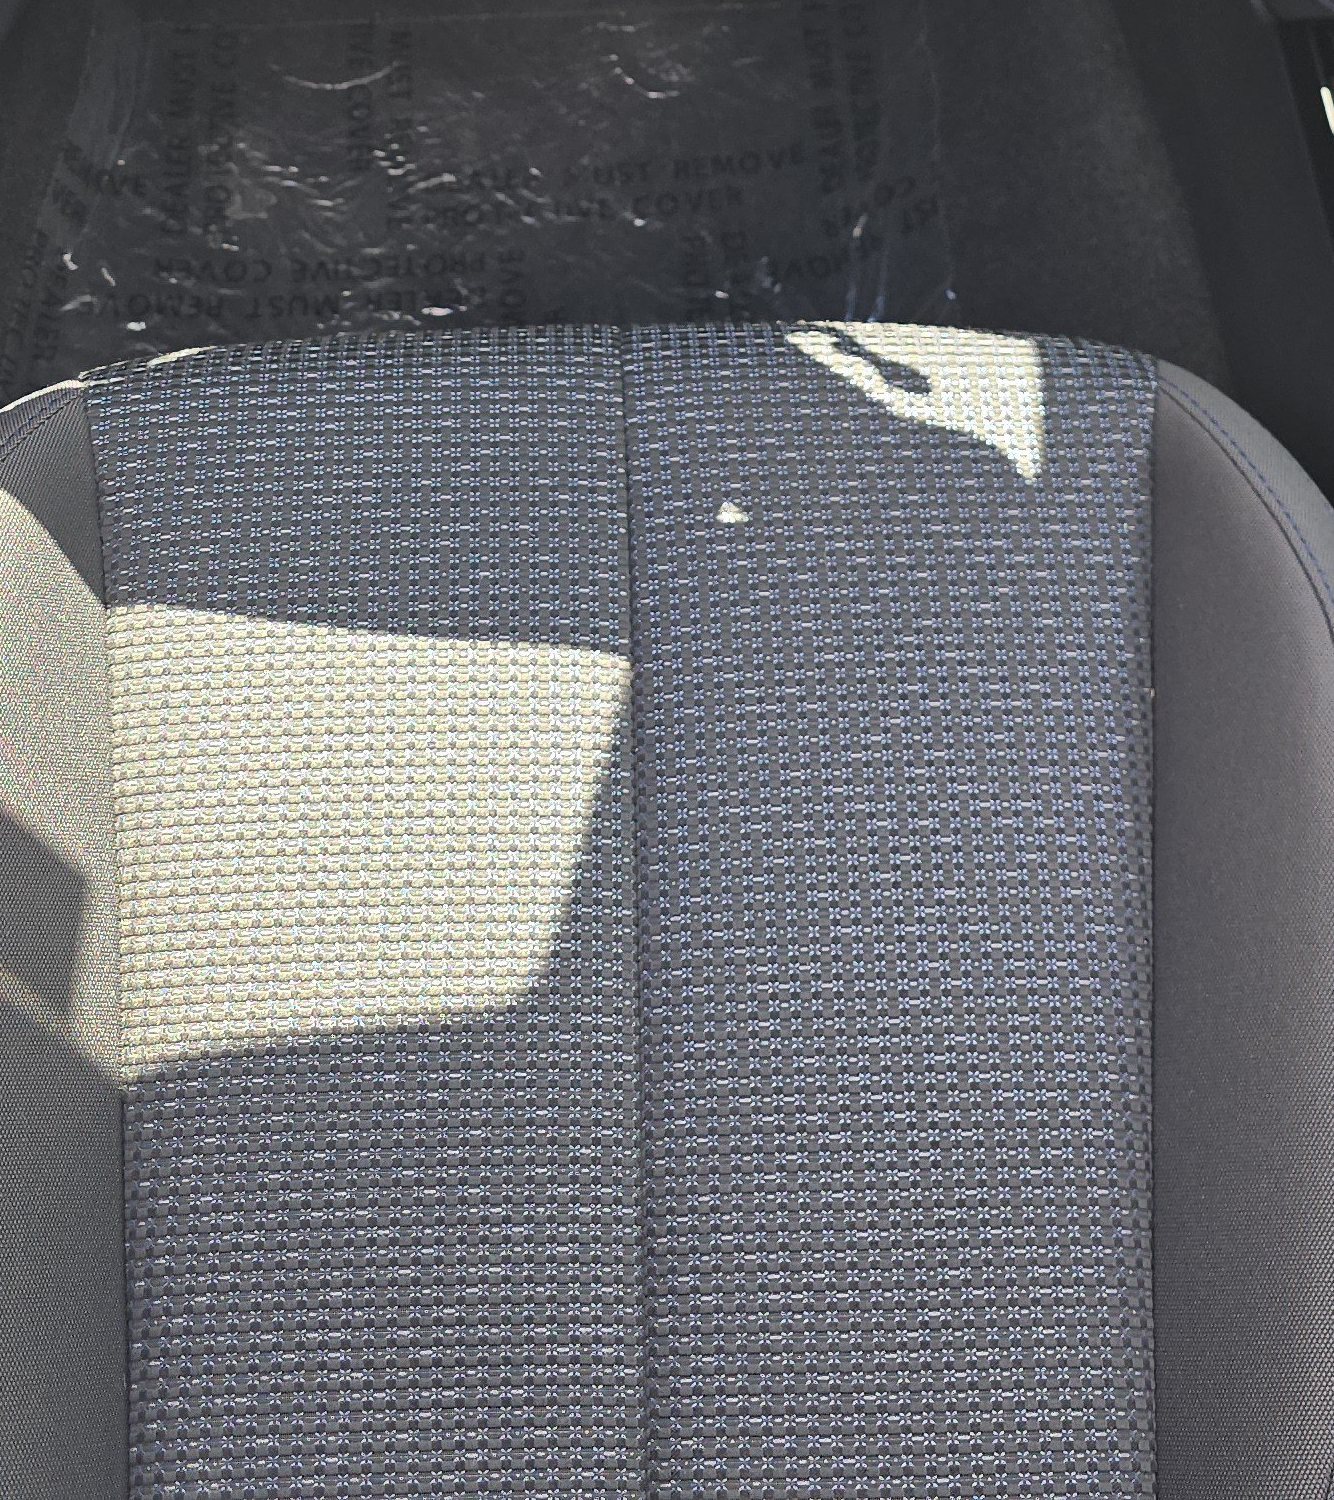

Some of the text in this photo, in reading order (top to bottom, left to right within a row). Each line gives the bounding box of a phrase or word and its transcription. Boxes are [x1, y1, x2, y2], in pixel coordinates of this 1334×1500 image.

[673, 141, 806, 180] REMOVE
[632, 184, 745, 221] COVER
[252, 292, 342, 318] MUST
